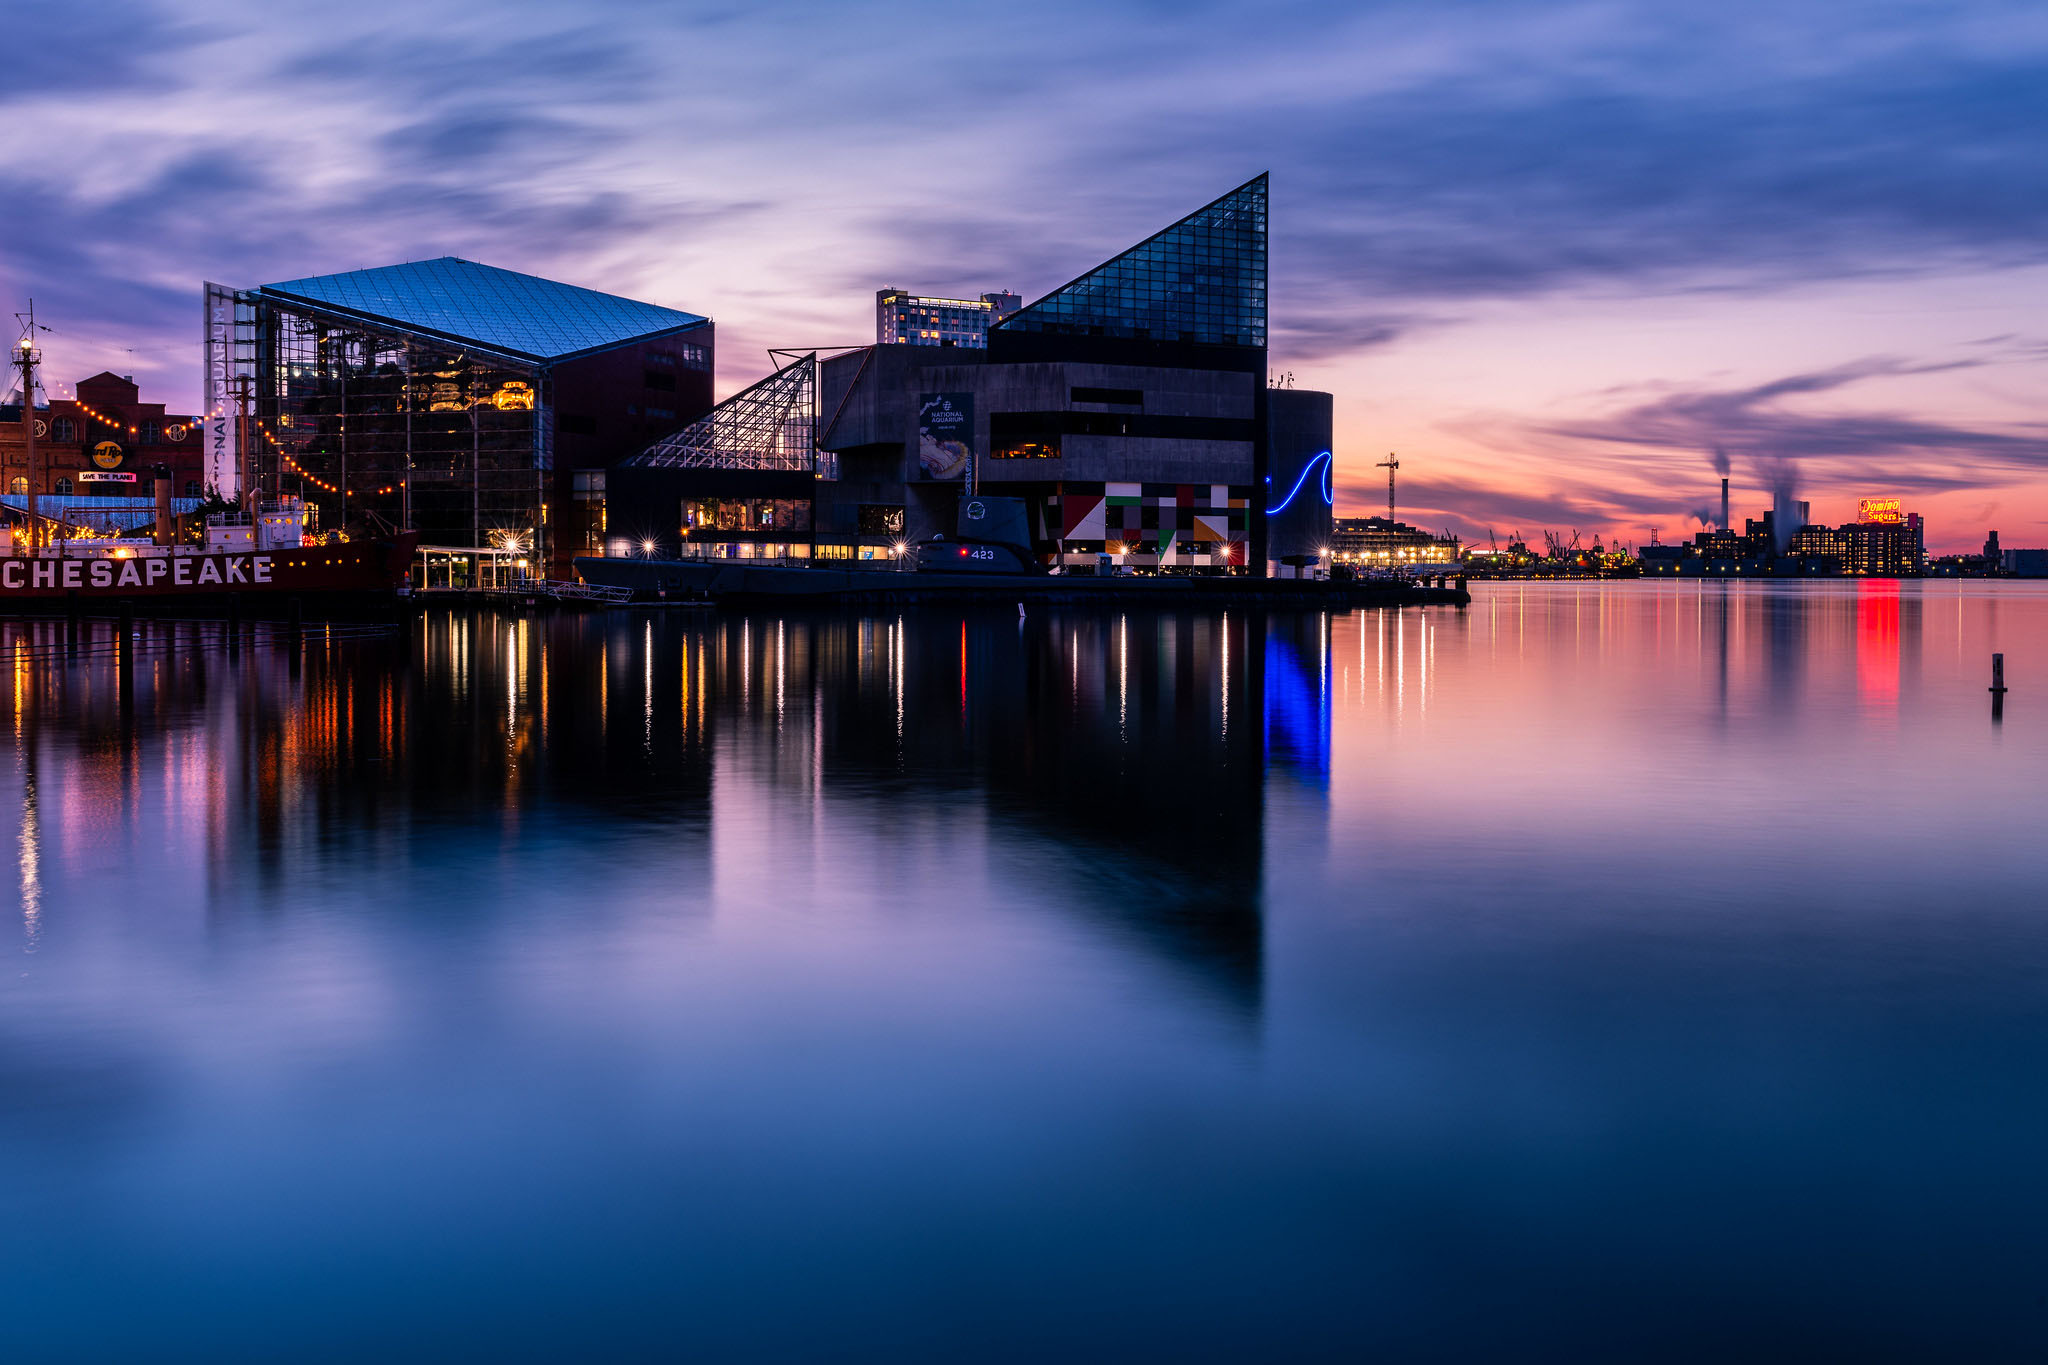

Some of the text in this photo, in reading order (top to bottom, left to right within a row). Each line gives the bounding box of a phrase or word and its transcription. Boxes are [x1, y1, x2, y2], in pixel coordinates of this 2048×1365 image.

[213, 307, 225, 407] AQUARIUM
[1861, 500, 1899, 513] Domino
[1868, 511, 1897, 522] Sugars
[971, 550, 994, 560] 423
[2, 556, 273, 589] CHESAPEAKE
